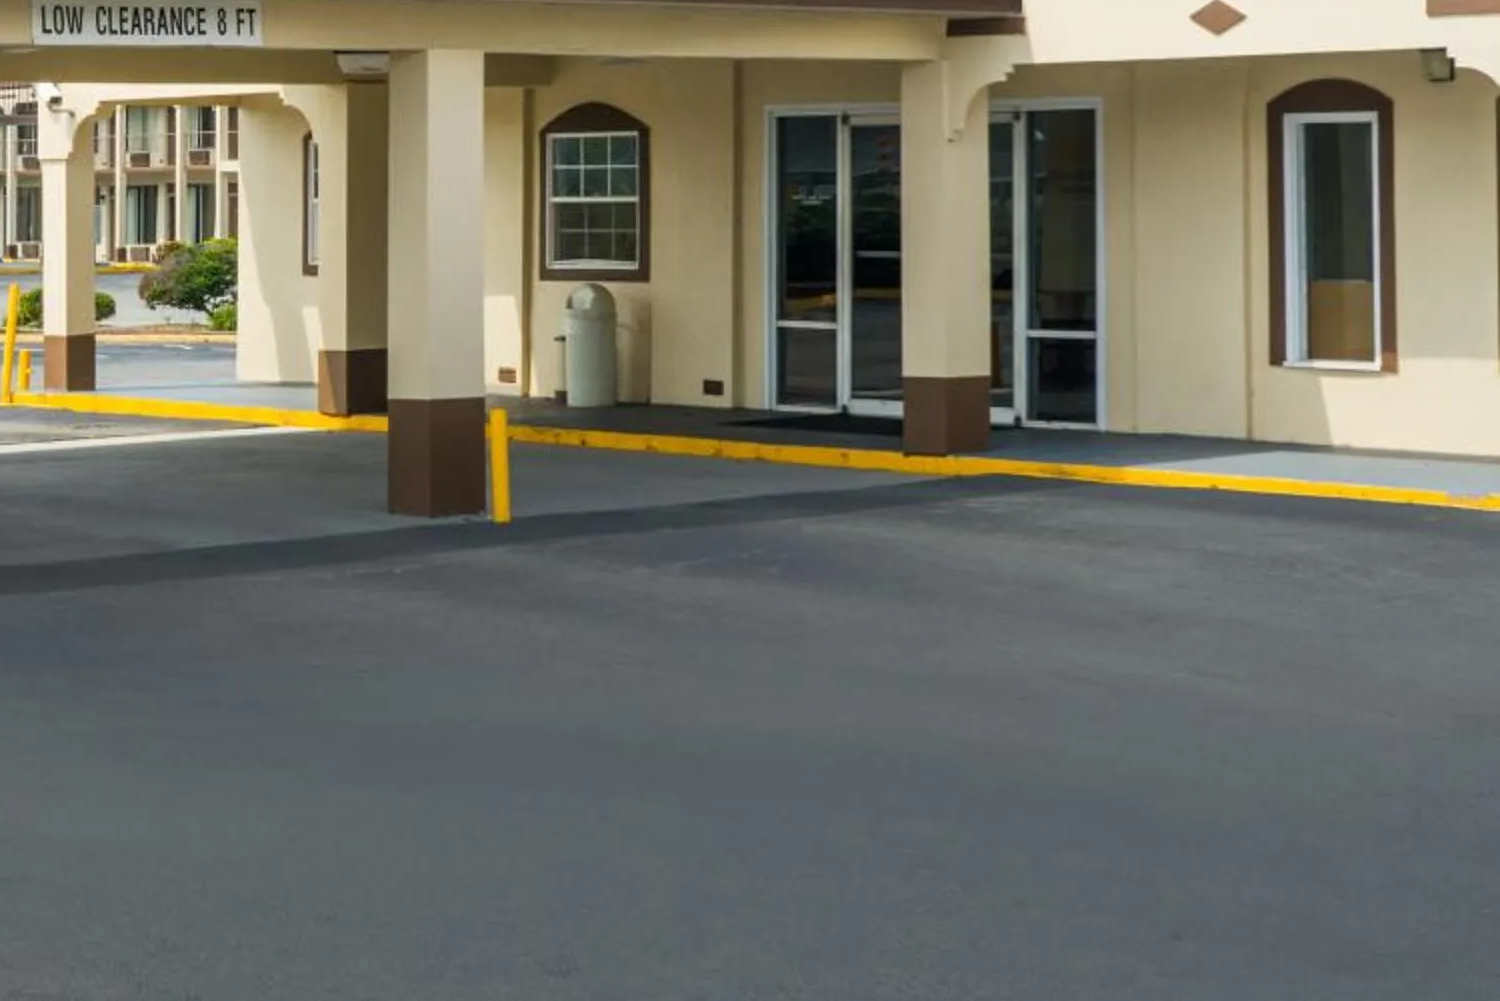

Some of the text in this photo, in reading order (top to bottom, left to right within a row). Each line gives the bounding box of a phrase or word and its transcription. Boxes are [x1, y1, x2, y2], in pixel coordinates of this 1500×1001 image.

[40, 4, 257, 36] LOW CLEARANCE 8 FT
